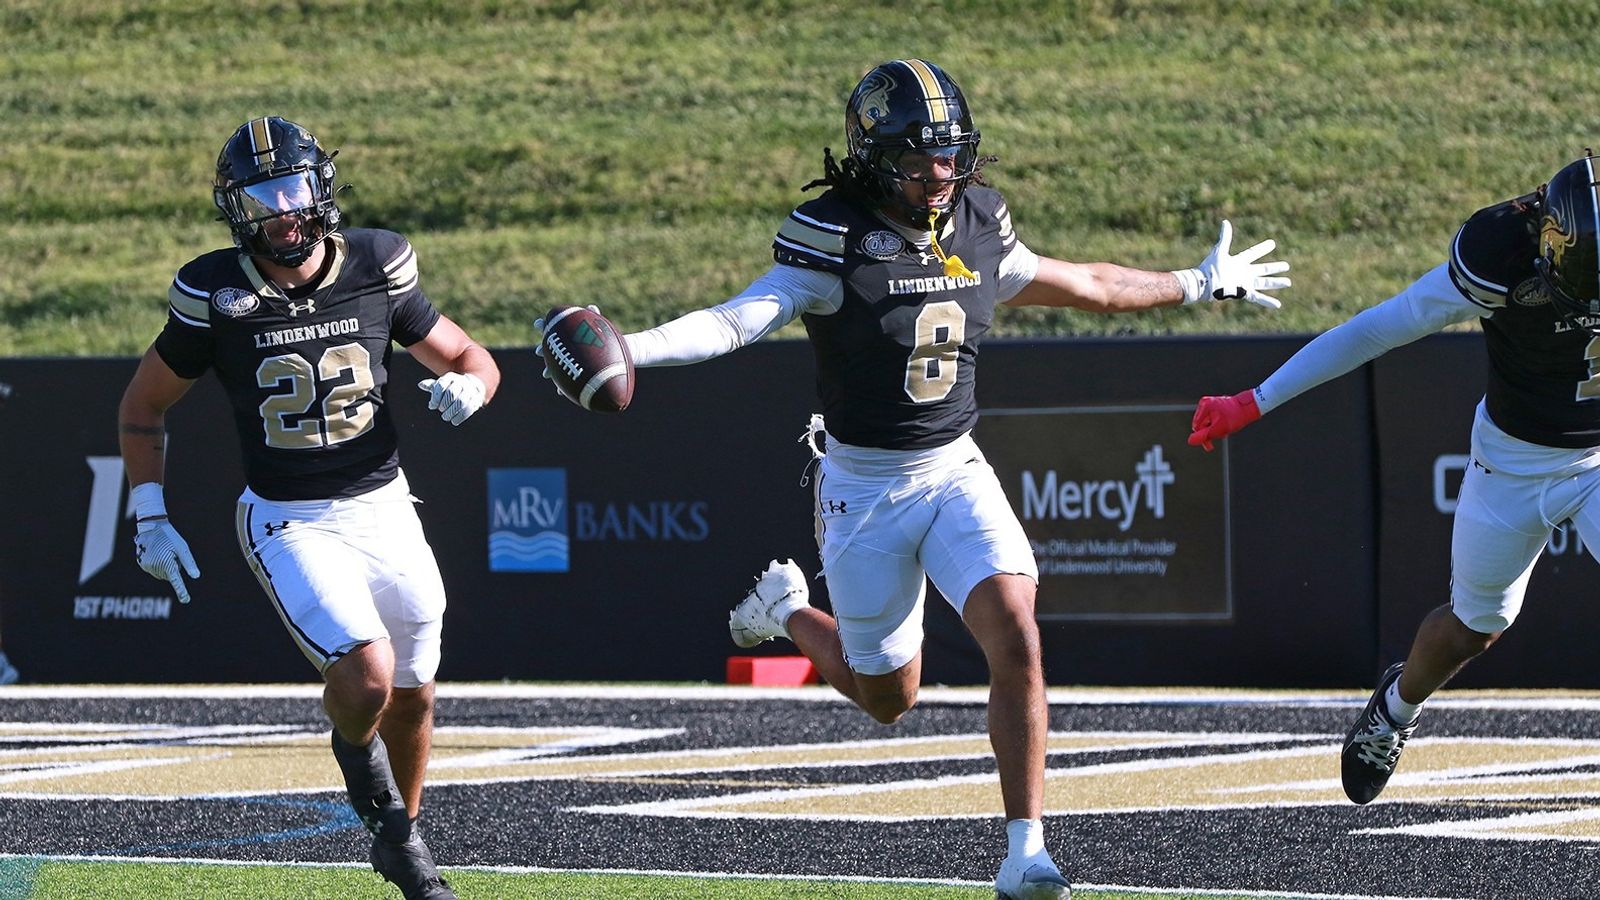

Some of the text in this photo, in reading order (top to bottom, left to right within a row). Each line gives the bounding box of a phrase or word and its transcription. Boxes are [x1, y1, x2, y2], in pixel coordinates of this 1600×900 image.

[888, 270, 981, 295] LINDENWOOD
[254, 317, 360, 348] LINDENWOOD
[904, 300, 966, 403] 8
[256, 342, 375, 448] 22
[1021, 470, 1142, 531] Mercy
[576, 501, 709, 541] BANKS
[1049, 539, 1085, 555] Official
[1088, 539, 1129, 555] Medical
[1133, 539, 1177, 555] Provider
[1050, 558, 1109, 574] Lindenwood
[1113, 558, 1168, 577] University
[102, 596, 171, 619] PHORM
